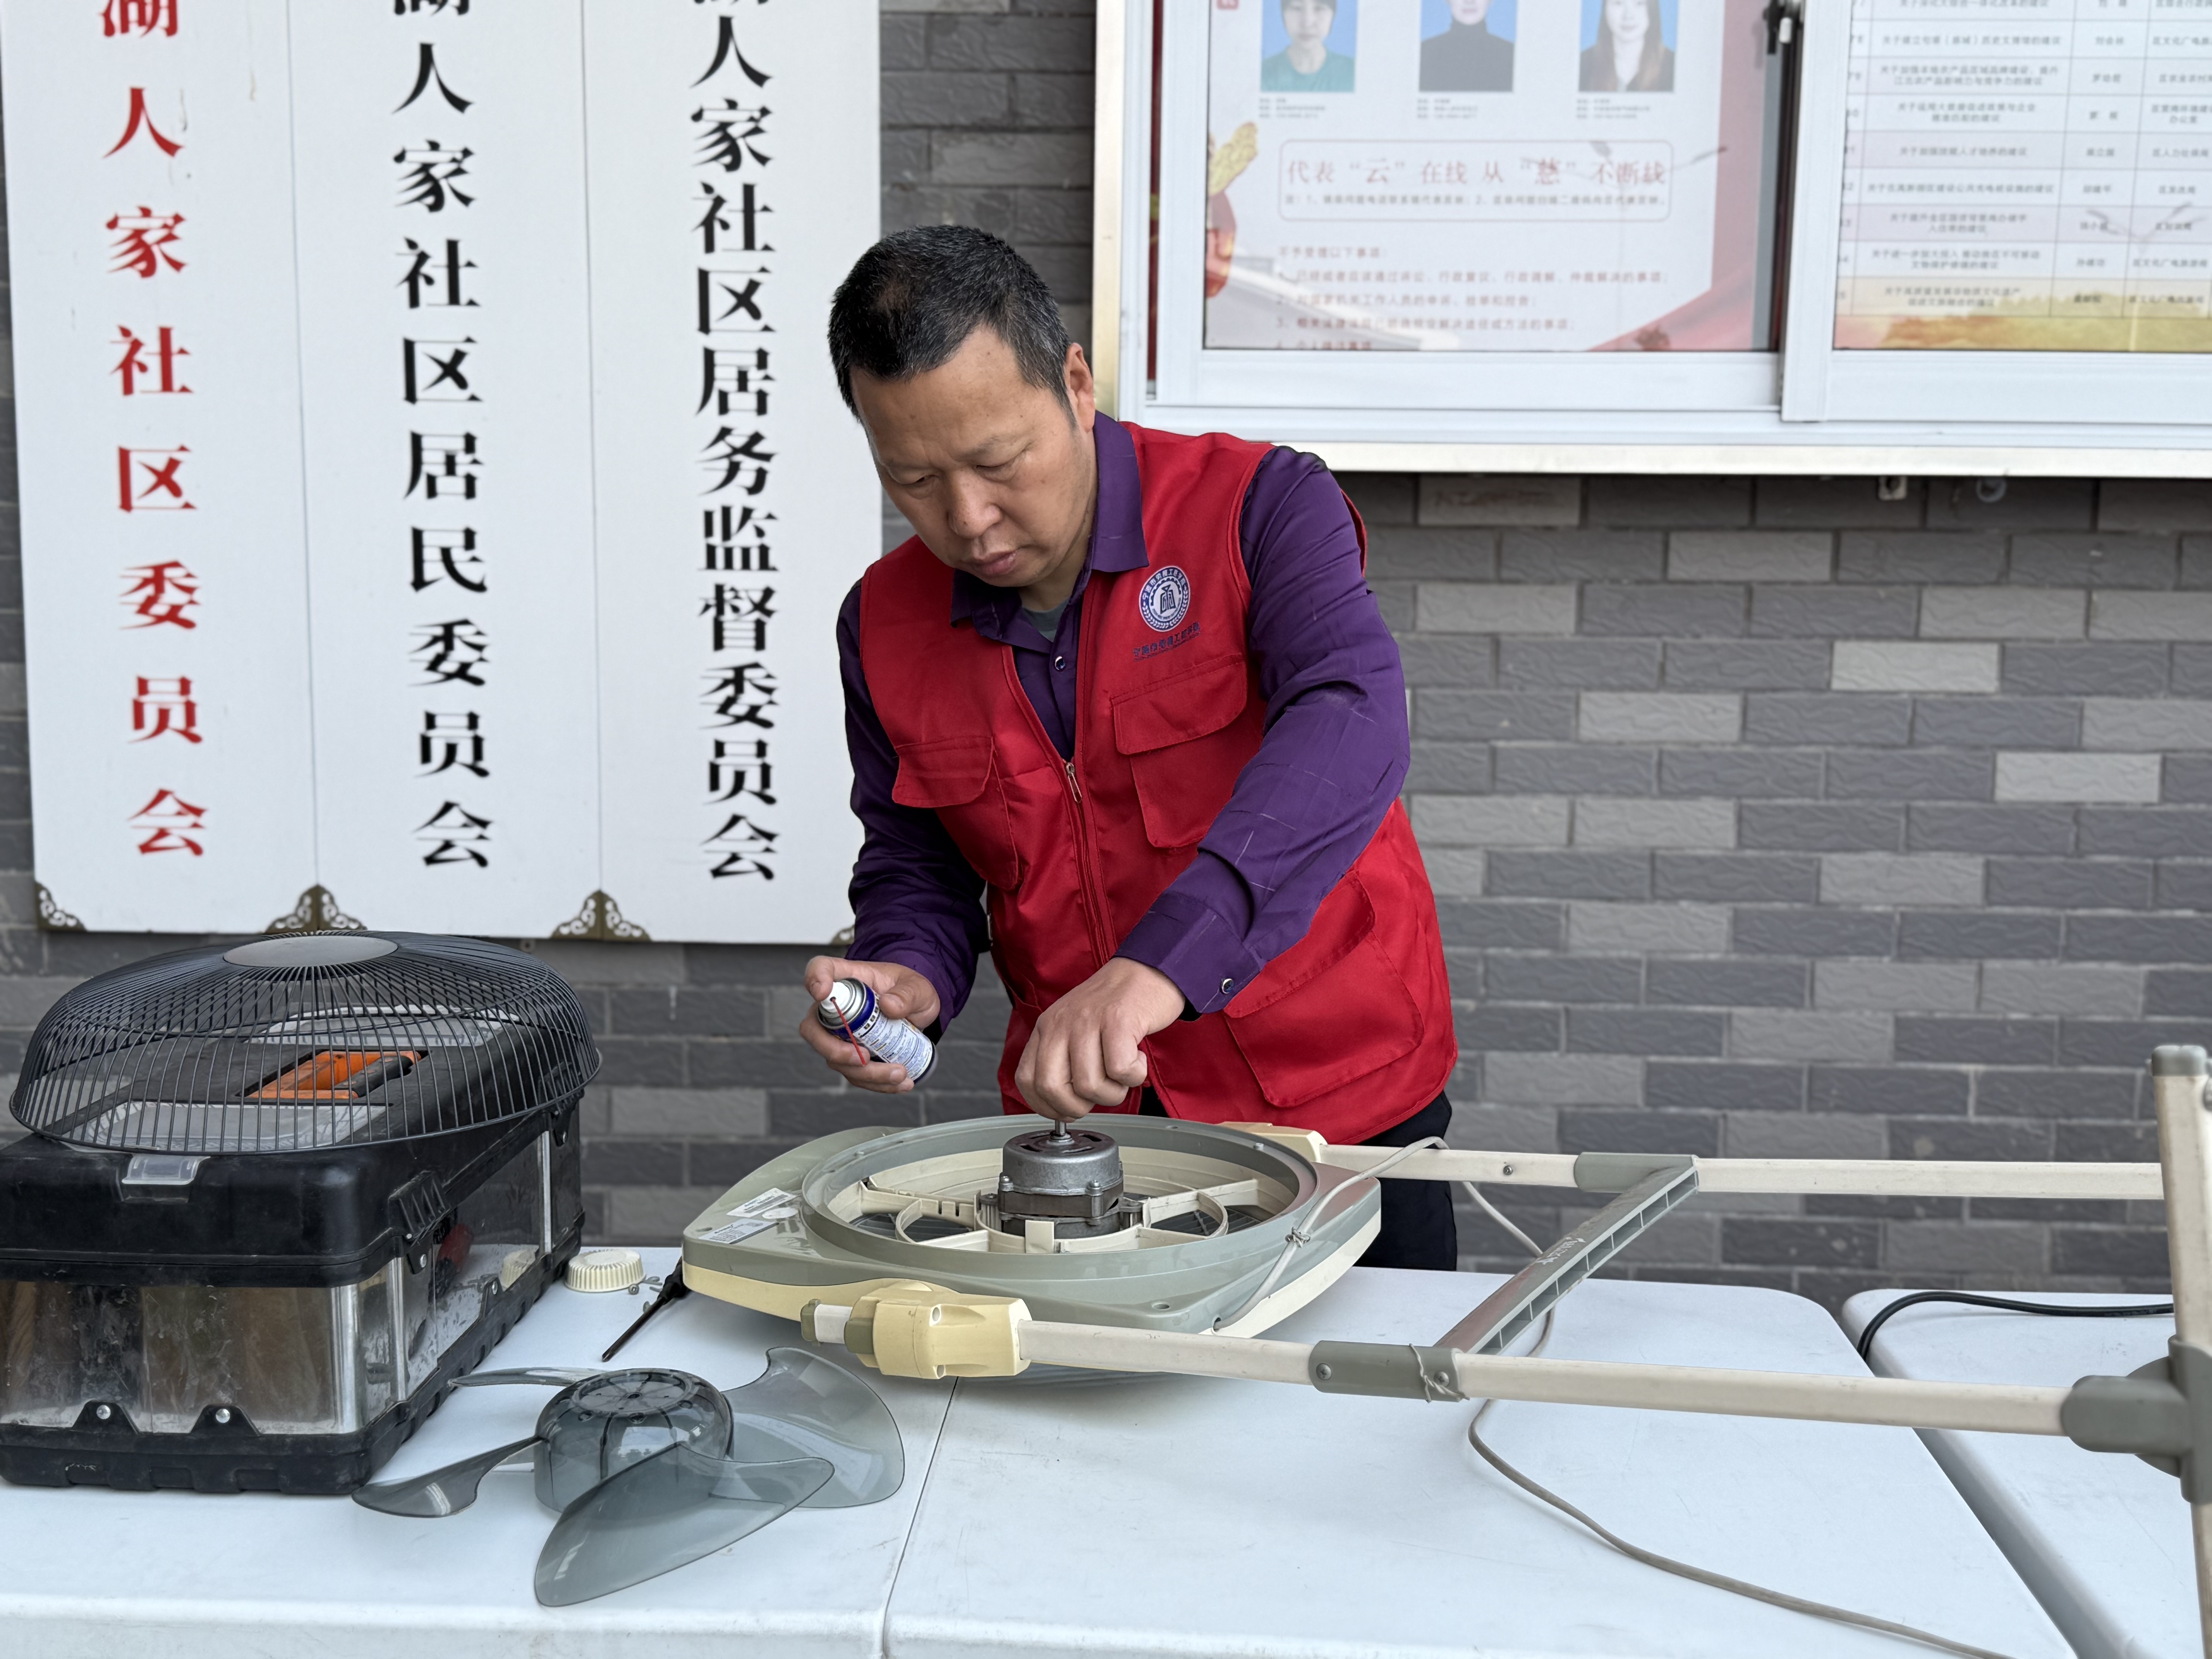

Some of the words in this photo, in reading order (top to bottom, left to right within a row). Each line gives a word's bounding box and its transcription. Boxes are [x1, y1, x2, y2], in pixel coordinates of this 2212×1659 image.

[100, 0, 207, 856] 湖人家社区委员会
[393, 0, 491, 868] 人家社区居民委员会
[691, 0, 778, 880] 人家社区居务监督委员会
